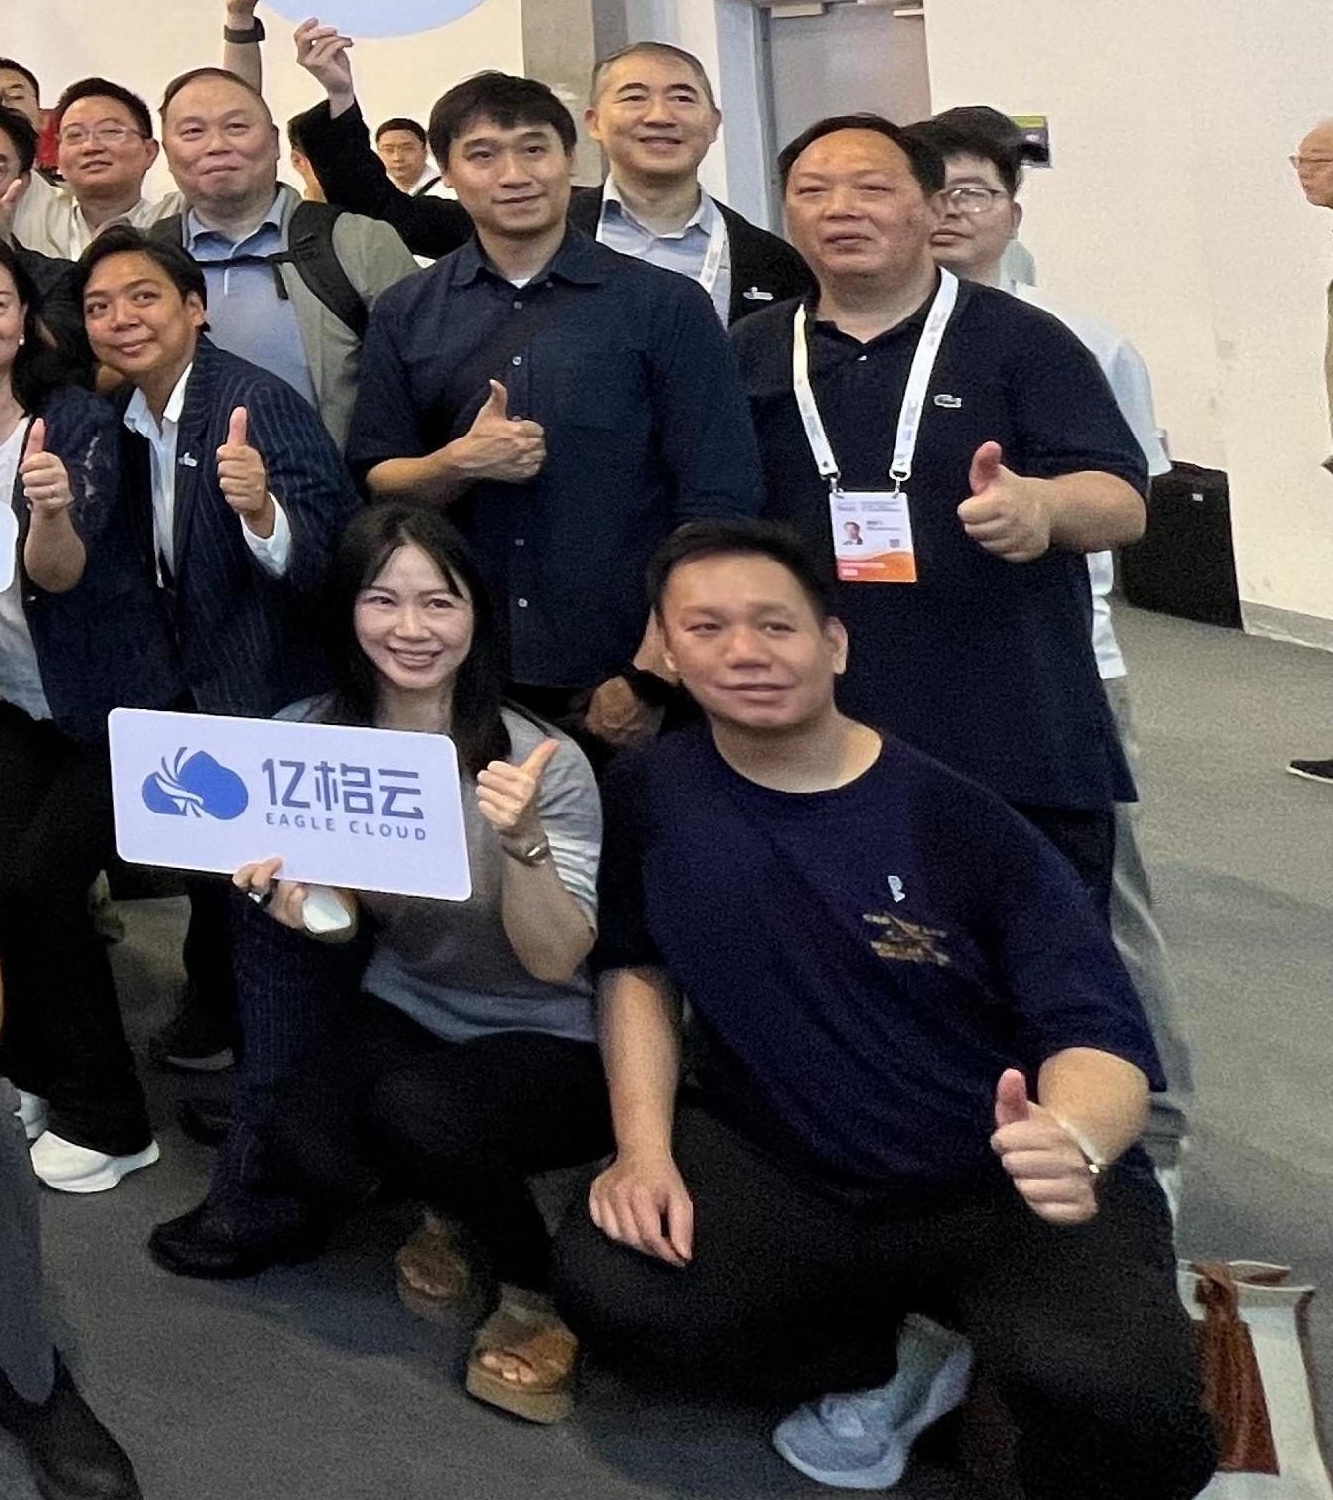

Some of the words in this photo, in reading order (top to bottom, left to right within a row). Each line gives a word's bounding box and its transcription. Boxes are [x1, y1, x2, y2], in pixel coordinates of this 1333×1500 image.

[261, 757, 426, 821] 亿格云
[265, 812, 336, 833] EAGLE
[349, 820, 428, 842] CLOUD
